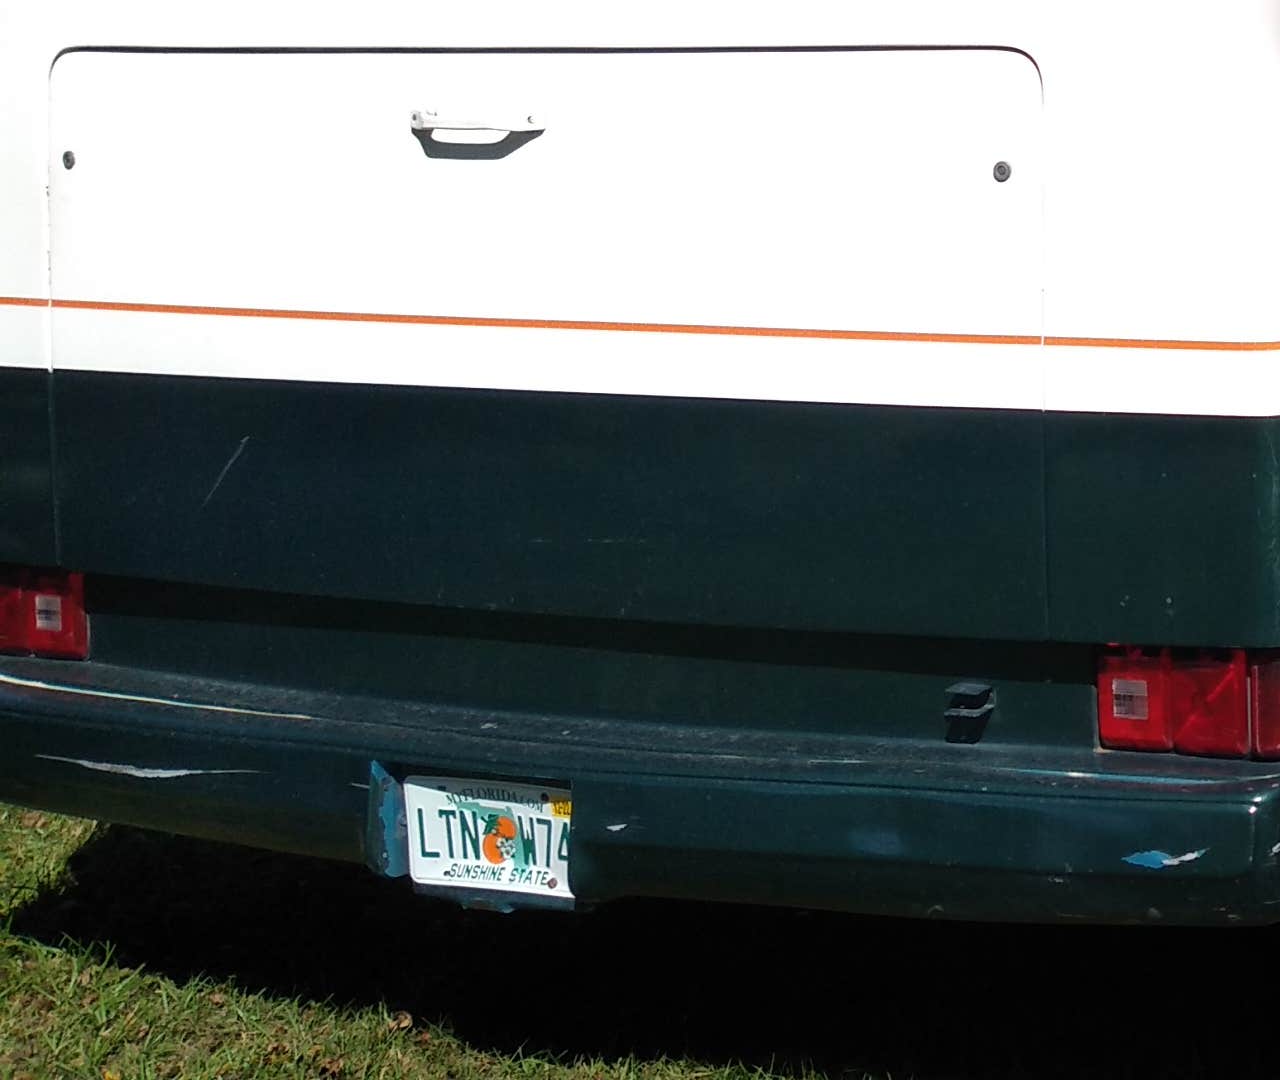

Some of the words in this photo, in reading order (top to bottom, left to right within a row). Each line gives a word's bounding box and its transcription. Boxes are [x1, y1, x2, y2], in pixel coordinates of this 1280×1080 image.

[418, 808, 480, 860] LTN
[449, 863, 505, 881] SUNSHINE
[508, 869, 549, 886] STATE
